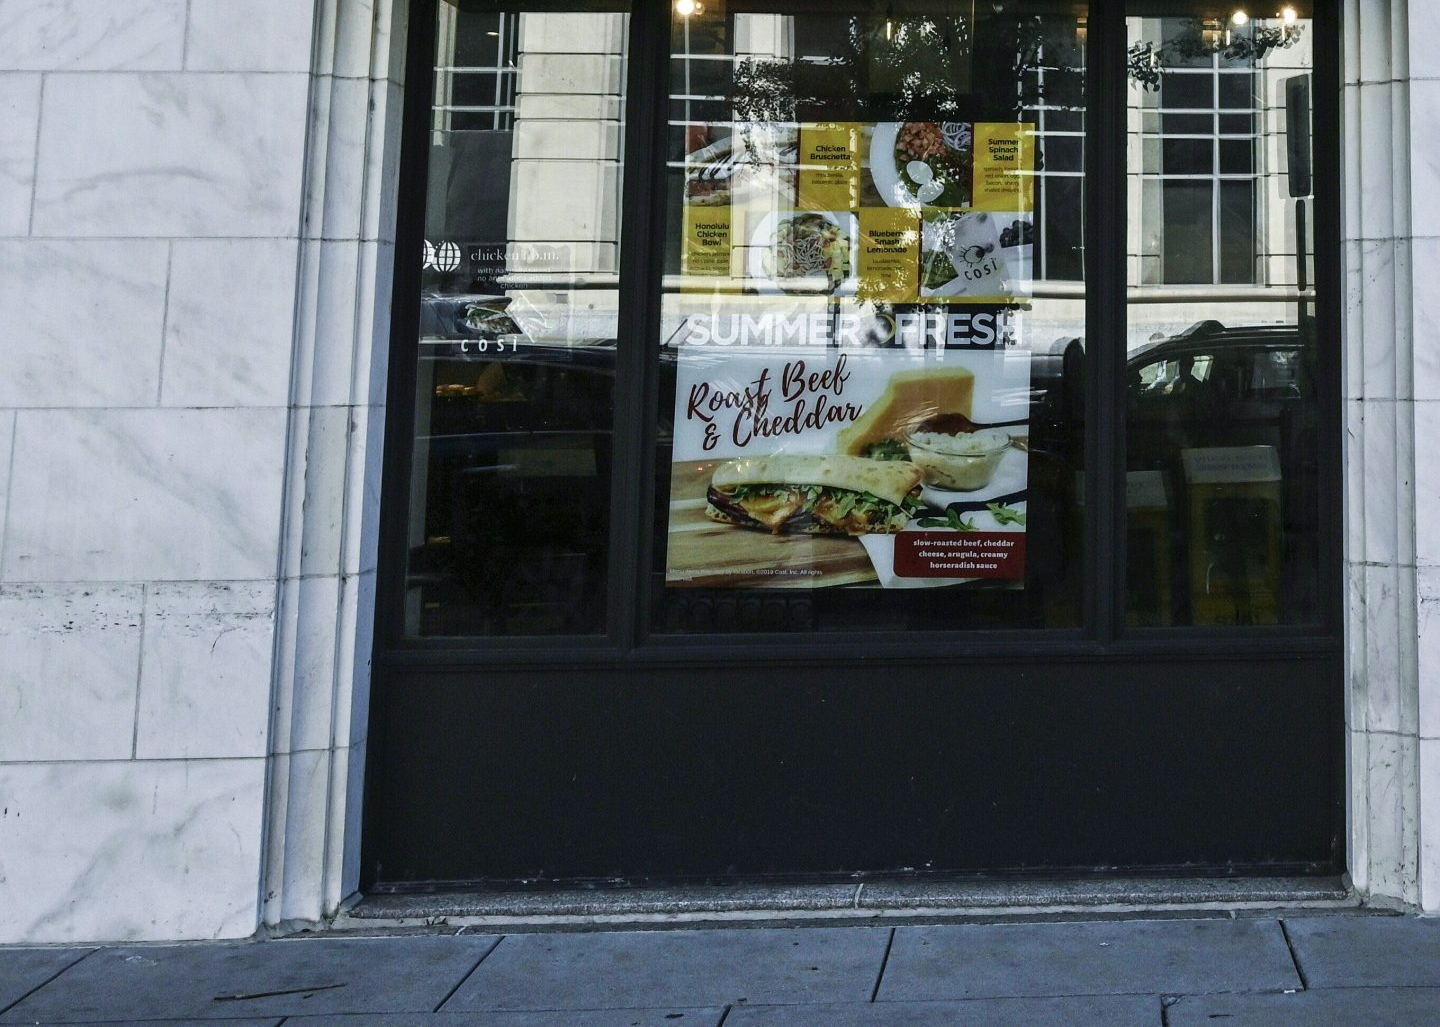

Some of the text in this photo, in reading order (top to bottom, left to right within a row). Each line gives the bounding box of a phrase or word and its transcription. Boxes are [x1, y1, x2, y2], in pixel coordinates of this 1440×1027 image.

[988, 138, 1019, 146] Summer
[988, 146, 1019, 154] Spinach
[810, 153, 851, 161] Bruschetta
[866, 246, 907, 254] Lemonade
[471, 249, 519, 261] chicken
[685, 313, 1023, 346] SUMMER FRESH
[687, 353, 851, 421] Roast Beef
[702, 395, 863, 451] & Cheddar
[913, 539, 961, 547] slow-roasted
[963, 539, 982, 547] beef,
[918, 550, 1008, 559] cheese, arugula, creamy
[930, 561, 975, 569] horseradish
